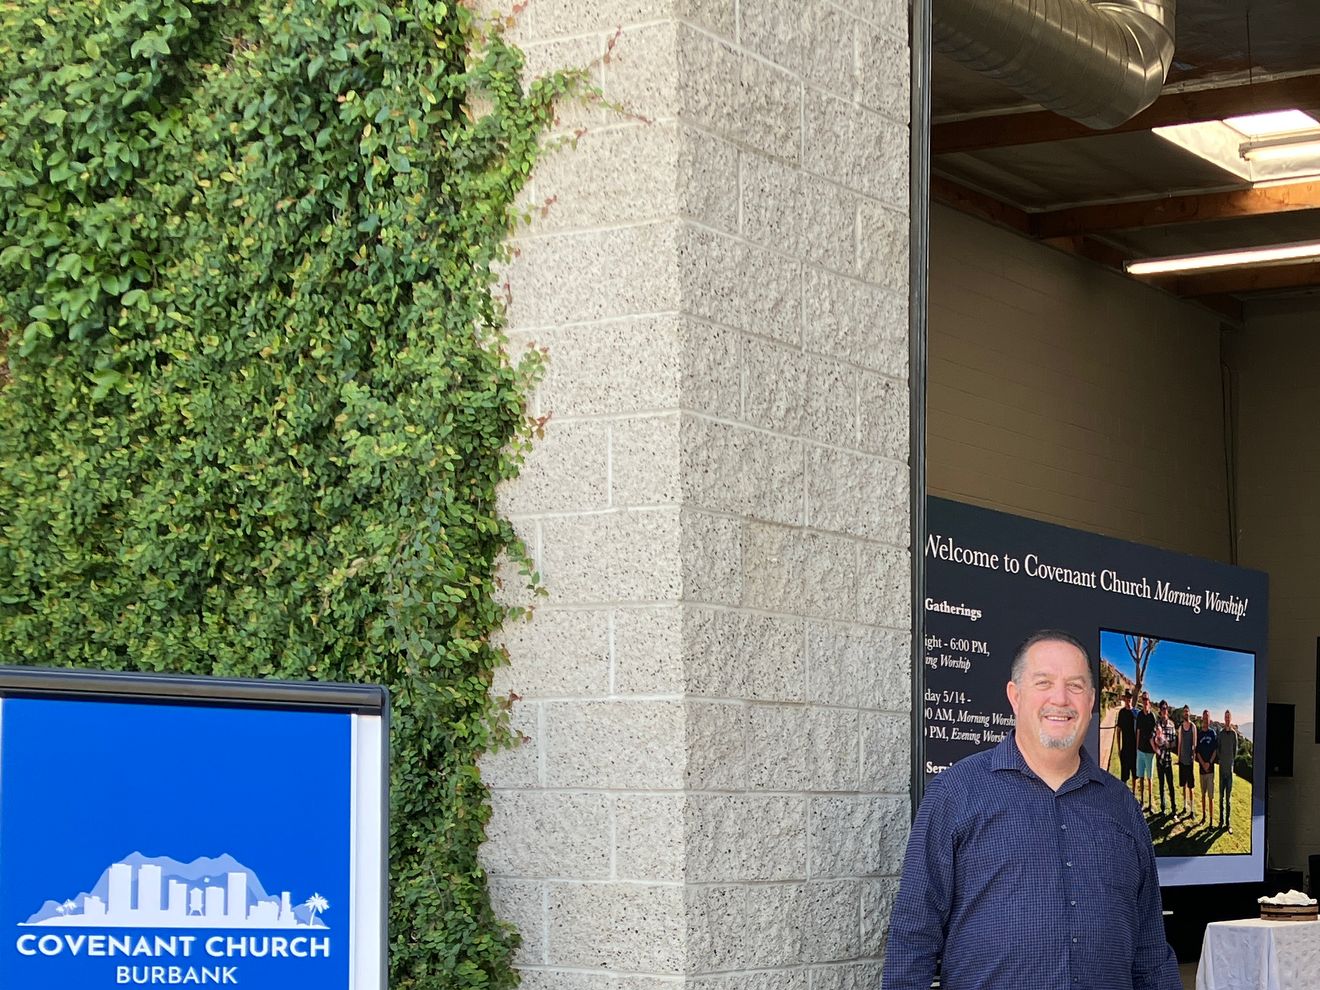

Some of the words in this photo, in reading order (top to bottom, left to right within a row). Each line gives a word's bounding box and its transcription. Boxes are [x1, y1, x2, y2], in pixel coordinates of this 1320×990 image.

[925, 533, 1000, 570] Welcome
[1003, 553, 1020, 574] to
[1024, 553, 1097, 589] Covenant
[1100, 569, 1152, 599] Church
[1153, 580, 1202, 614] Morning
[1205, 590, 1249, 621] Worship!
[925, 598, 982, 621] Gatherings
[925, 635, 942, 650] ight
[950, 638, 970, 652] 6:00
[971, 640, 990, 656] PM,
[940, 654, 971, 673] Worship
[925, 688, 941, 705] day
[943, 690, 966, 704] 5/14
[935, 708, 956, 724] AM,
[957, 710, 990, 727] Morning
[929, 726, 949, 741] PM,
[951, 727, 981, 745] Evening
[16, 933, 197, 958] COVENANT
[204, 936, 330, 958] CHURCH
[116, 966, 238, 985] BURBANK
